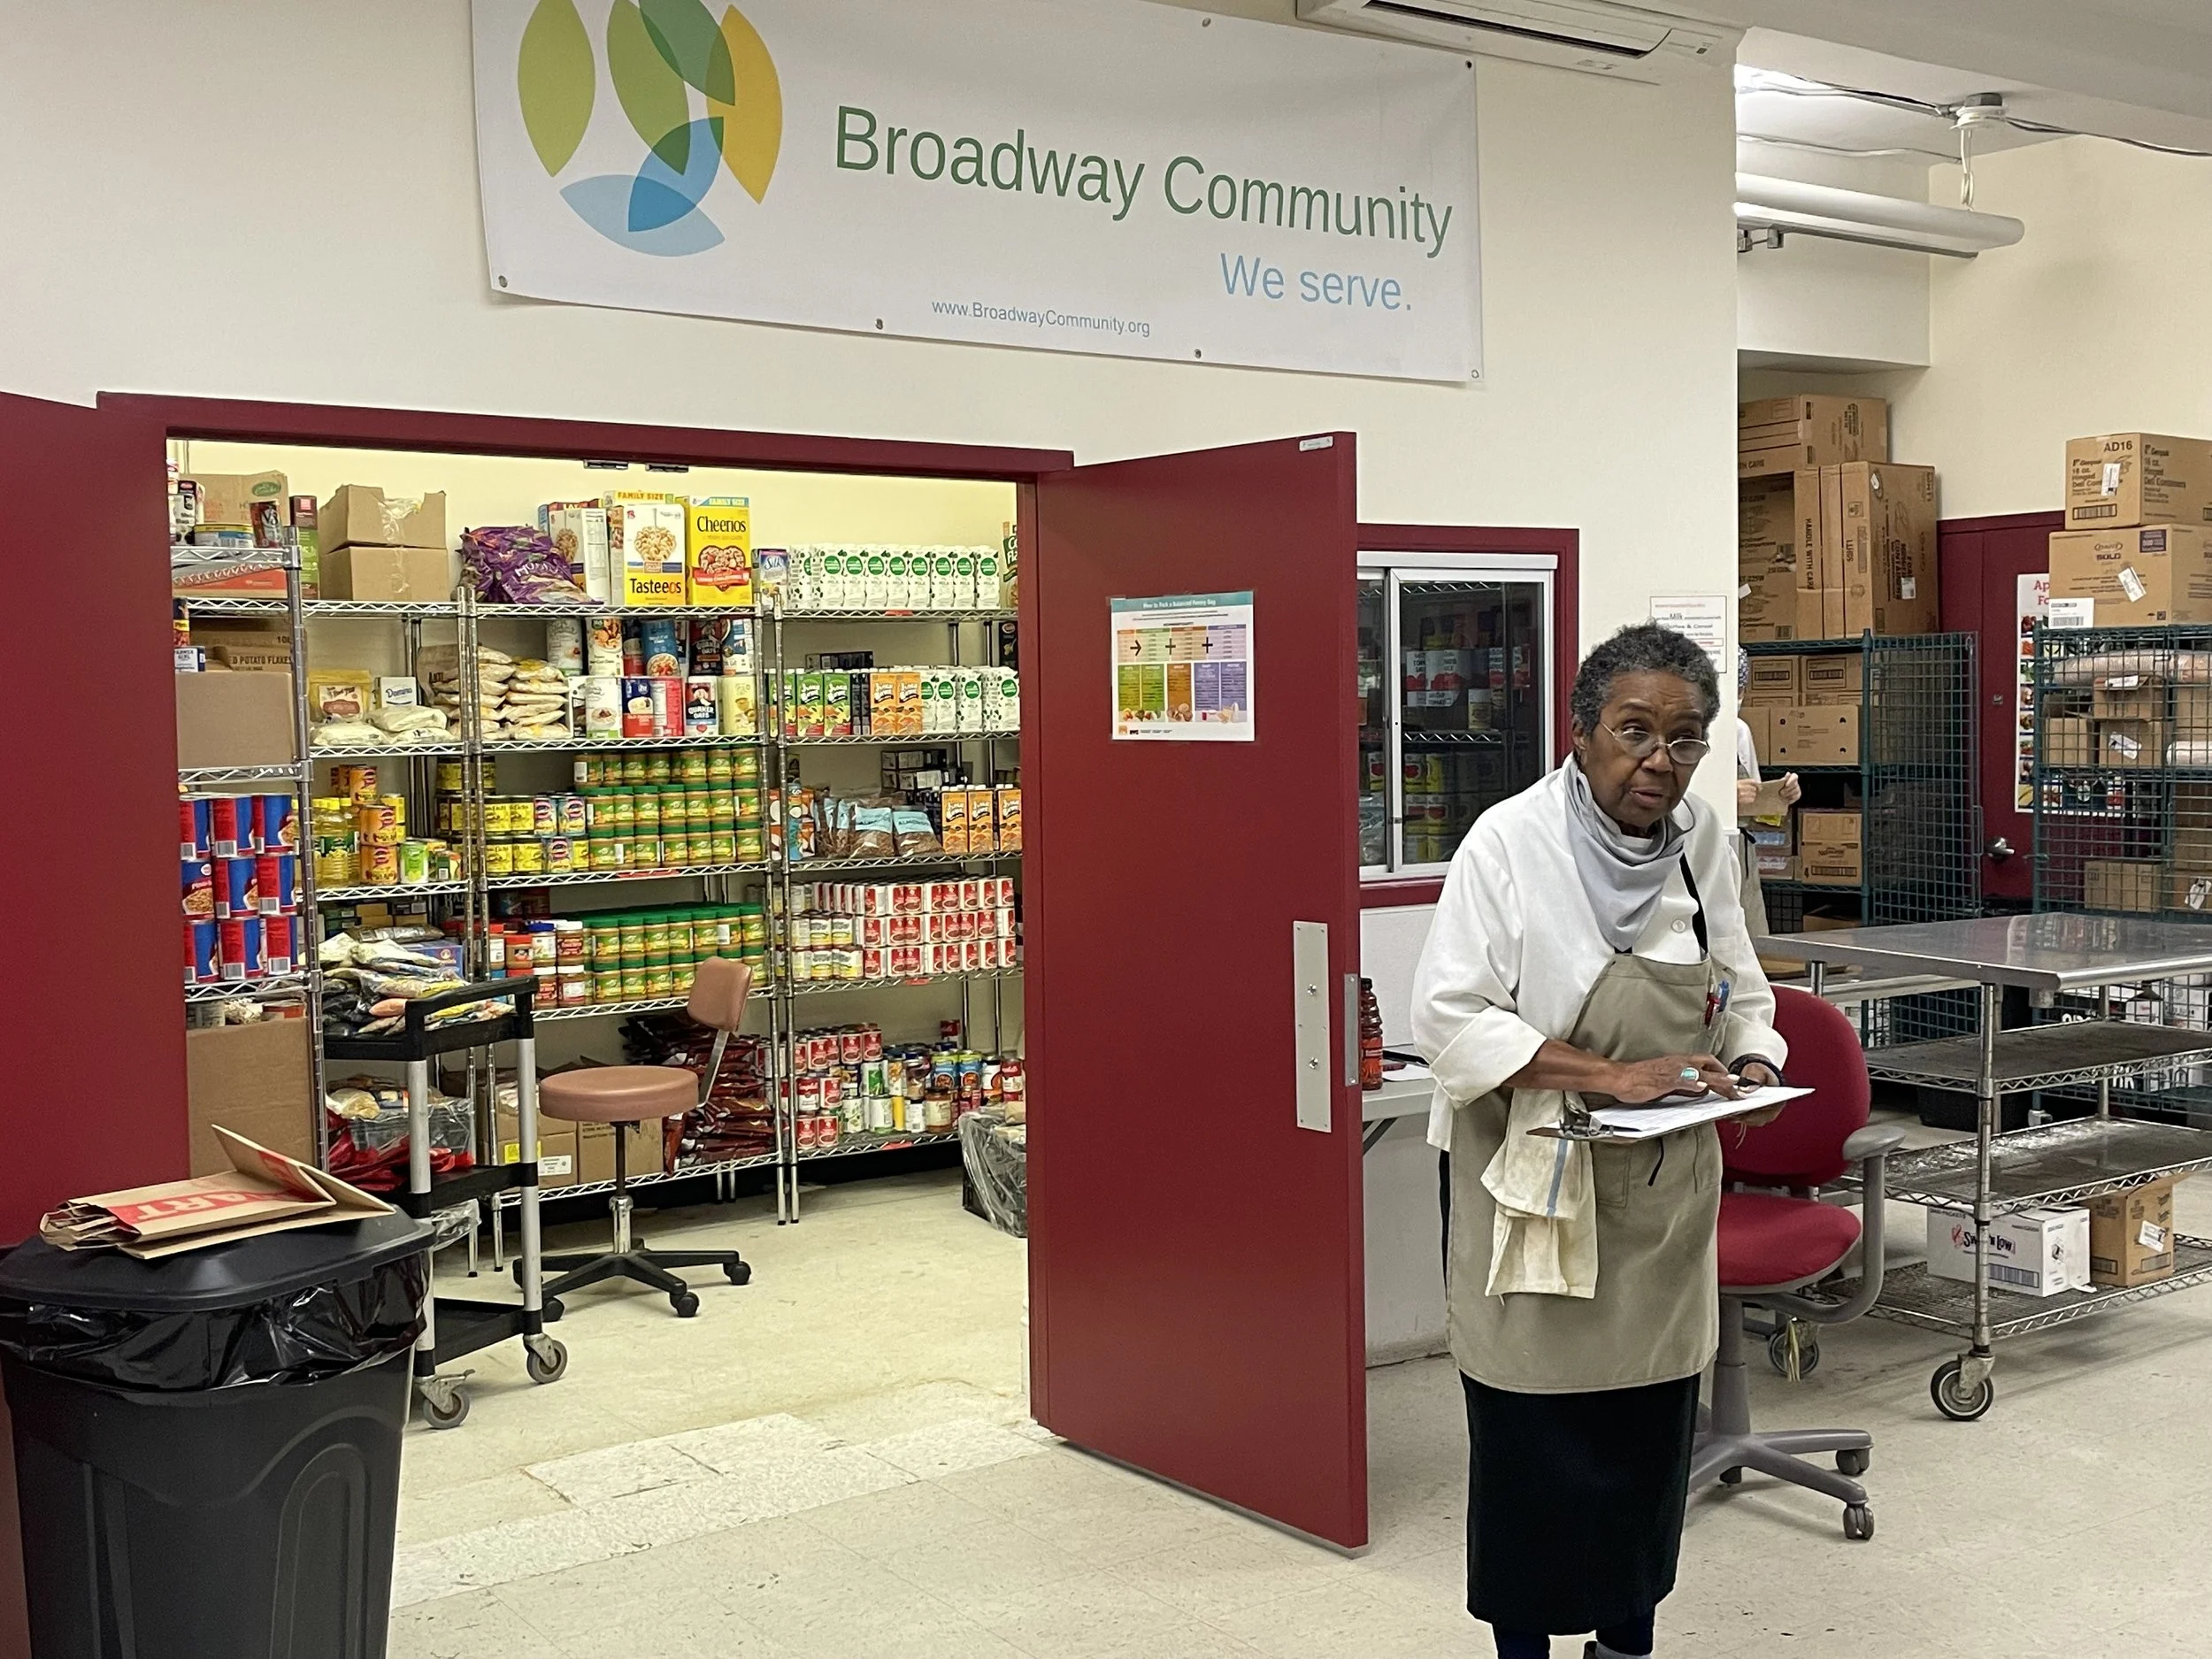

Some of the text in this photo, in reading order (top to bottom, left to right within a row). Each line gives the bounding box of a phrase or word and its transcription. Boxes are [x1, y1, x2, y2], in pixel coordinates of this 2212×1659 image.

[836, 105, 1453, 259] Broadway Community
[1220, 252, 1411, 311] We serve.
[932, 301, 1150, 338] www.BroadwayCommunity.org
[2103, 440, 2133, 453] AD16
[696, 515, 746, 533] Cheerios
[629, 578, 681, 594] Tasteeos
[240, 656, 265, 664] POTATO
[385, 687, 413, 699] Domino
